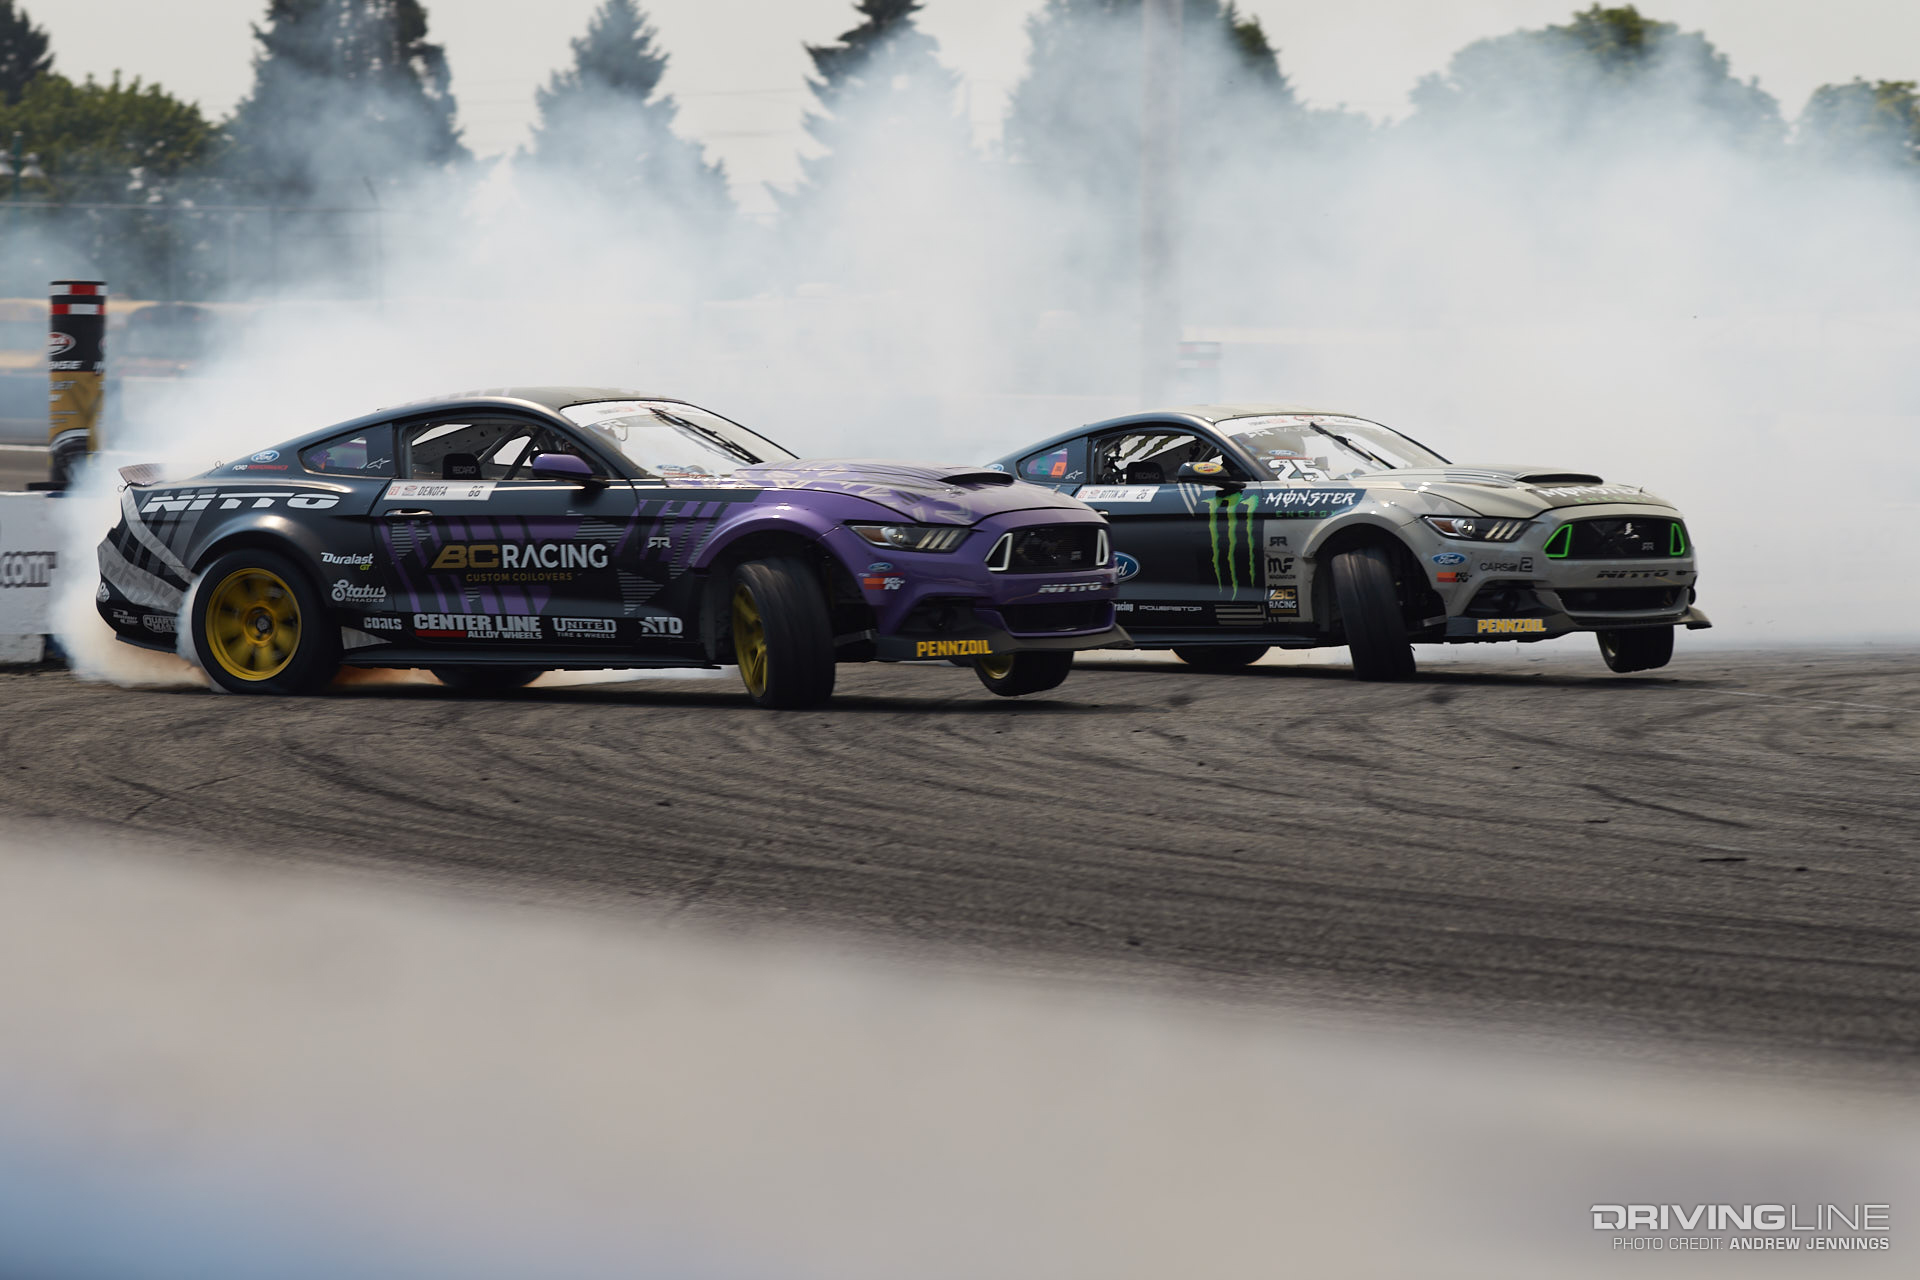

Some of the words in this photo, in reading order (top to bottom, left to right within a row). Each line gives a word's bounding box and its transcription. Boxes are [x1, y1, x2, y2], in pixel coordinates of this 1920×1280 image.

[1268, 459, 1330, 482] 25
[416, 486, 449, 496] DENOFA
[140, 492, 340, 513] NITTO
[320, 551, 374, 565] Duralast
[431, 544, 499, 569] BC
[502, 543, 609, 569] RACING
[466, 572, 510, 582] CUSTOM
[512, 571, 573, 582] COILOVERS
[1596, 569, 1671, 579] NITTO
[331, 579, 387, 602] Status
[1037, 581, 1102, 594] NITTO
[1269, 588, 1297, 600] BC
[1138, 604, 1203, 612] POWERSTOP
[1268, 600, 1297, 609] RACING
[413, 613, 492, 631] CENTER
[495, 615, 541, 632] LINE
[1477, 618, 1547, 634] PENNZOIL
[467, 630, 500, 639] ALLOY
[502, 631, 543, 640] WHEELS
[916, 639, 993, 658] PENNZOIL
